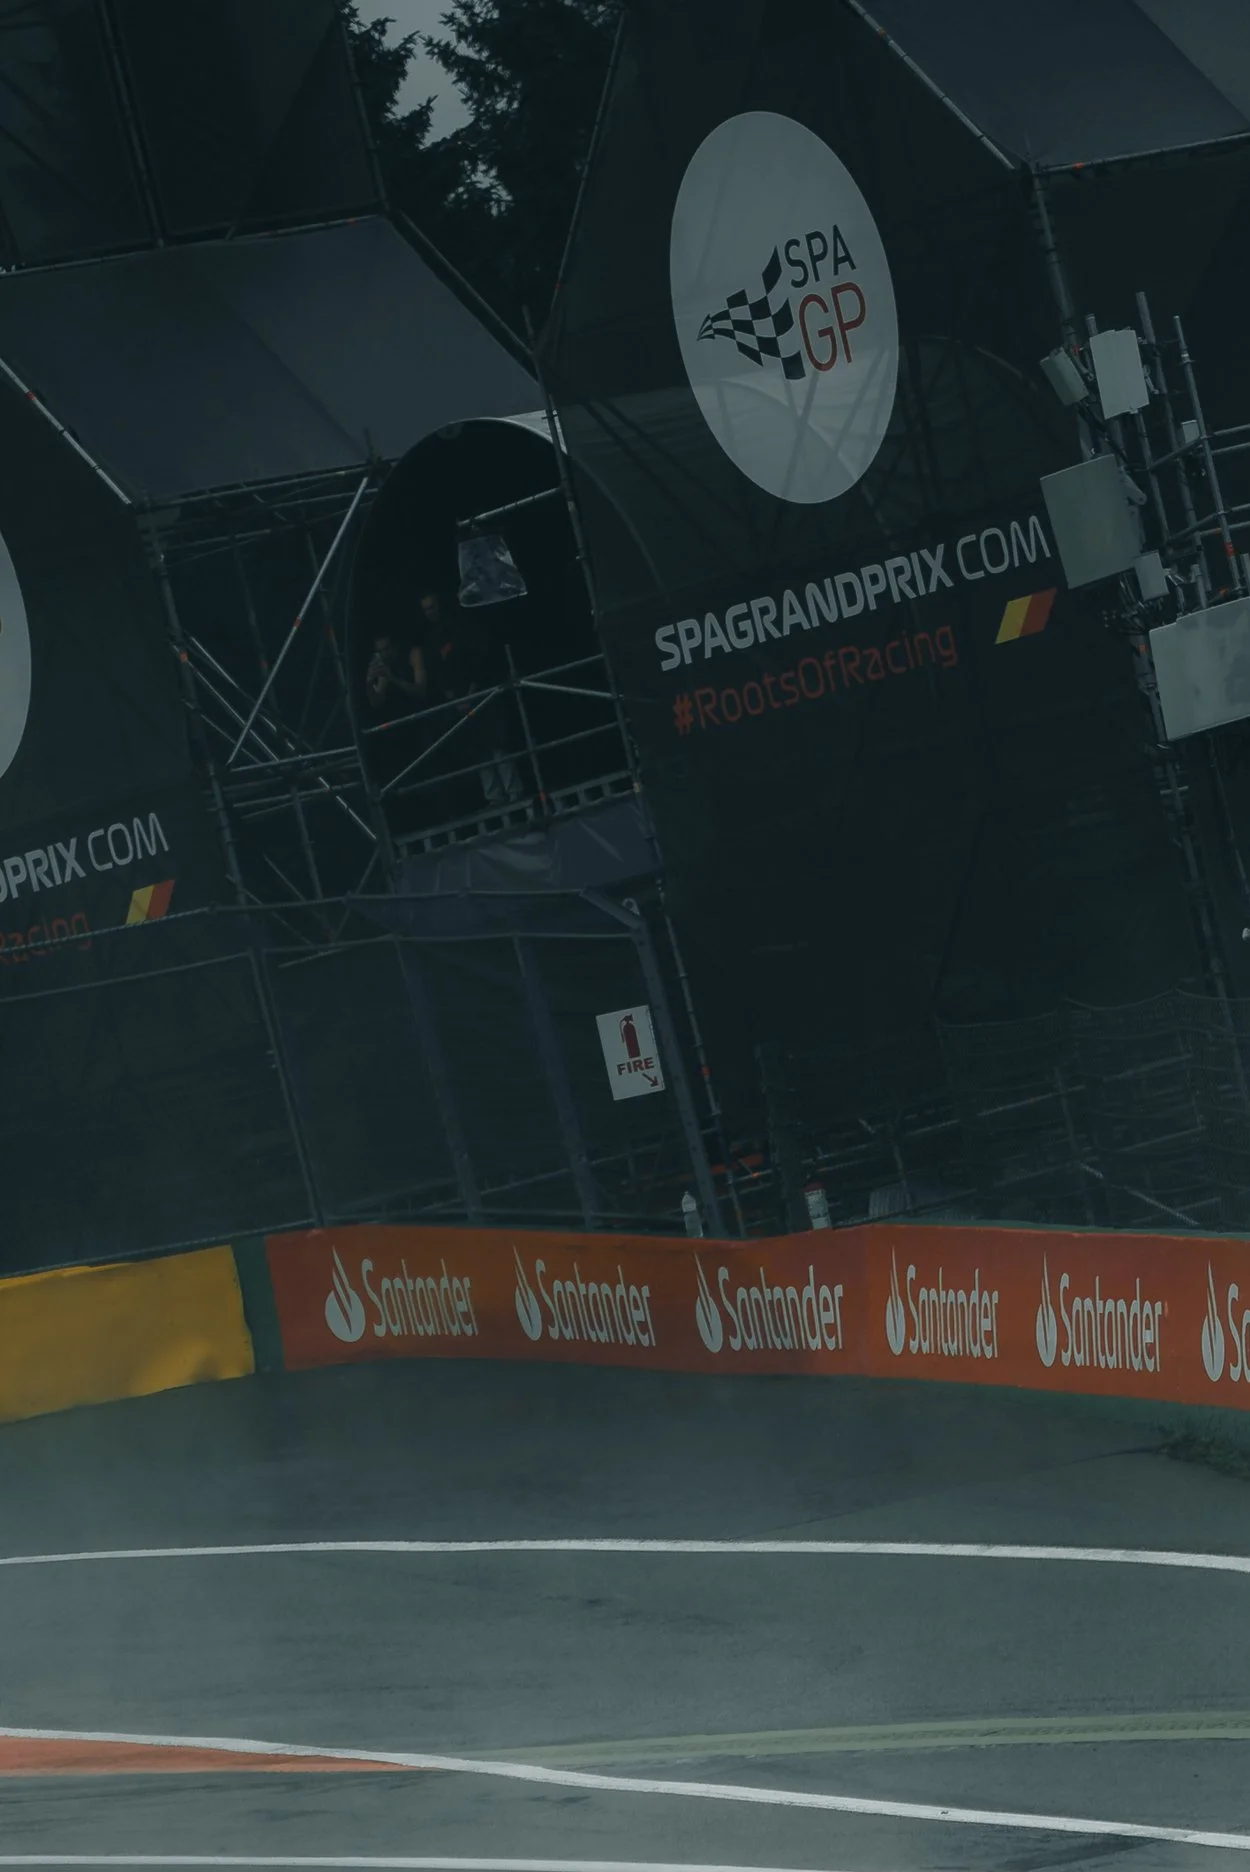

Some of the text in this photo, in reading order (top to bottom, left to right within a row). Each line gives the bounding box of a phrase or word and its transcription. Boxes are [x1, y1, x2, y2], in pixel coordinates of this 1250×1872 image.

[784, 225, 856, 288] SPA
[799, 282, 866, 371] GP
[672, 625, 959, 737] #RootsOfRacing
[617, 1057, 655, 1076] FIRE
[361, 1258, 478, 1336] Santander
[535, 1258, 655, 1347] Santander
[718, 1265, 843, 1351] Santander
[906, 1264, 999, 1360] Santander
[1059, 1274, 1162, 1372] Santander
